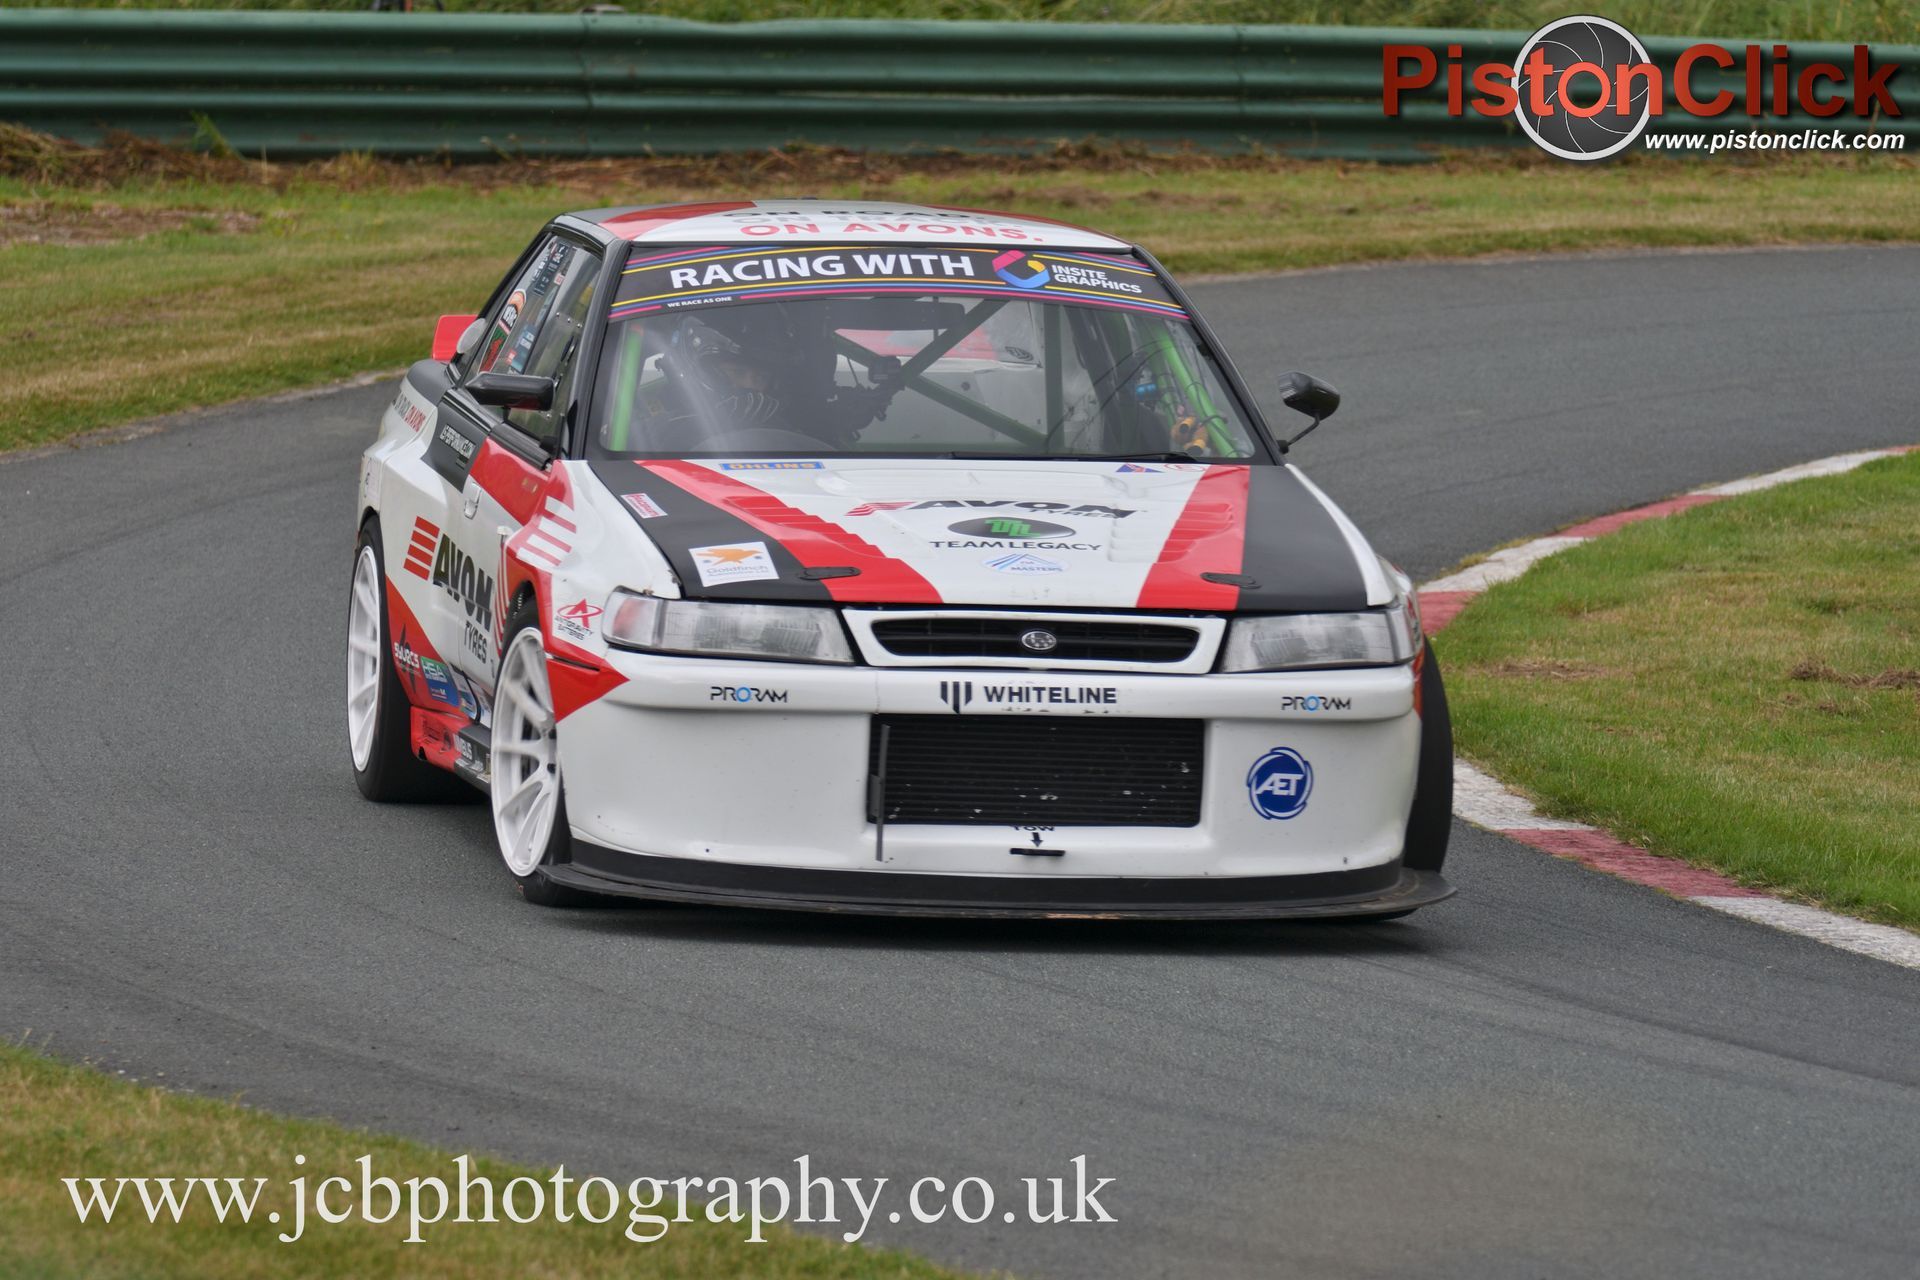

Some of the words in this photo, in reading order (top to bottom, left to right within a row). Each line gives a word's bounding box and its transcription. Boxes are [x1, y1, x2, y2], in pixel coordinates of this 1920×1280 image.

[740, 223, 820, 236] ON
[843, 223, 1044, 242] AVONS.
[670, 256, 845, 289] RACING
[852, 254, 975, 277] WITH
[1051, 264, 1108, 281] INSITE
[1054, 273, 1142, 294] GRAPHICS
[905, 500, 1137, 519] AVON
[929, 541, 1003, 549] TEAM
[1008, 541, 1103, 551] LEGACY
[433, 533, 493, 632] AVON
[464, 620, 488, 664] TYRES
[710, 686, 788, 703] PRORAM
[983, 686, 1117, 704] WHITELINE
[1281, 695, 1351, 711] PRORAM
[1256, 772, 1304, 796] AET
